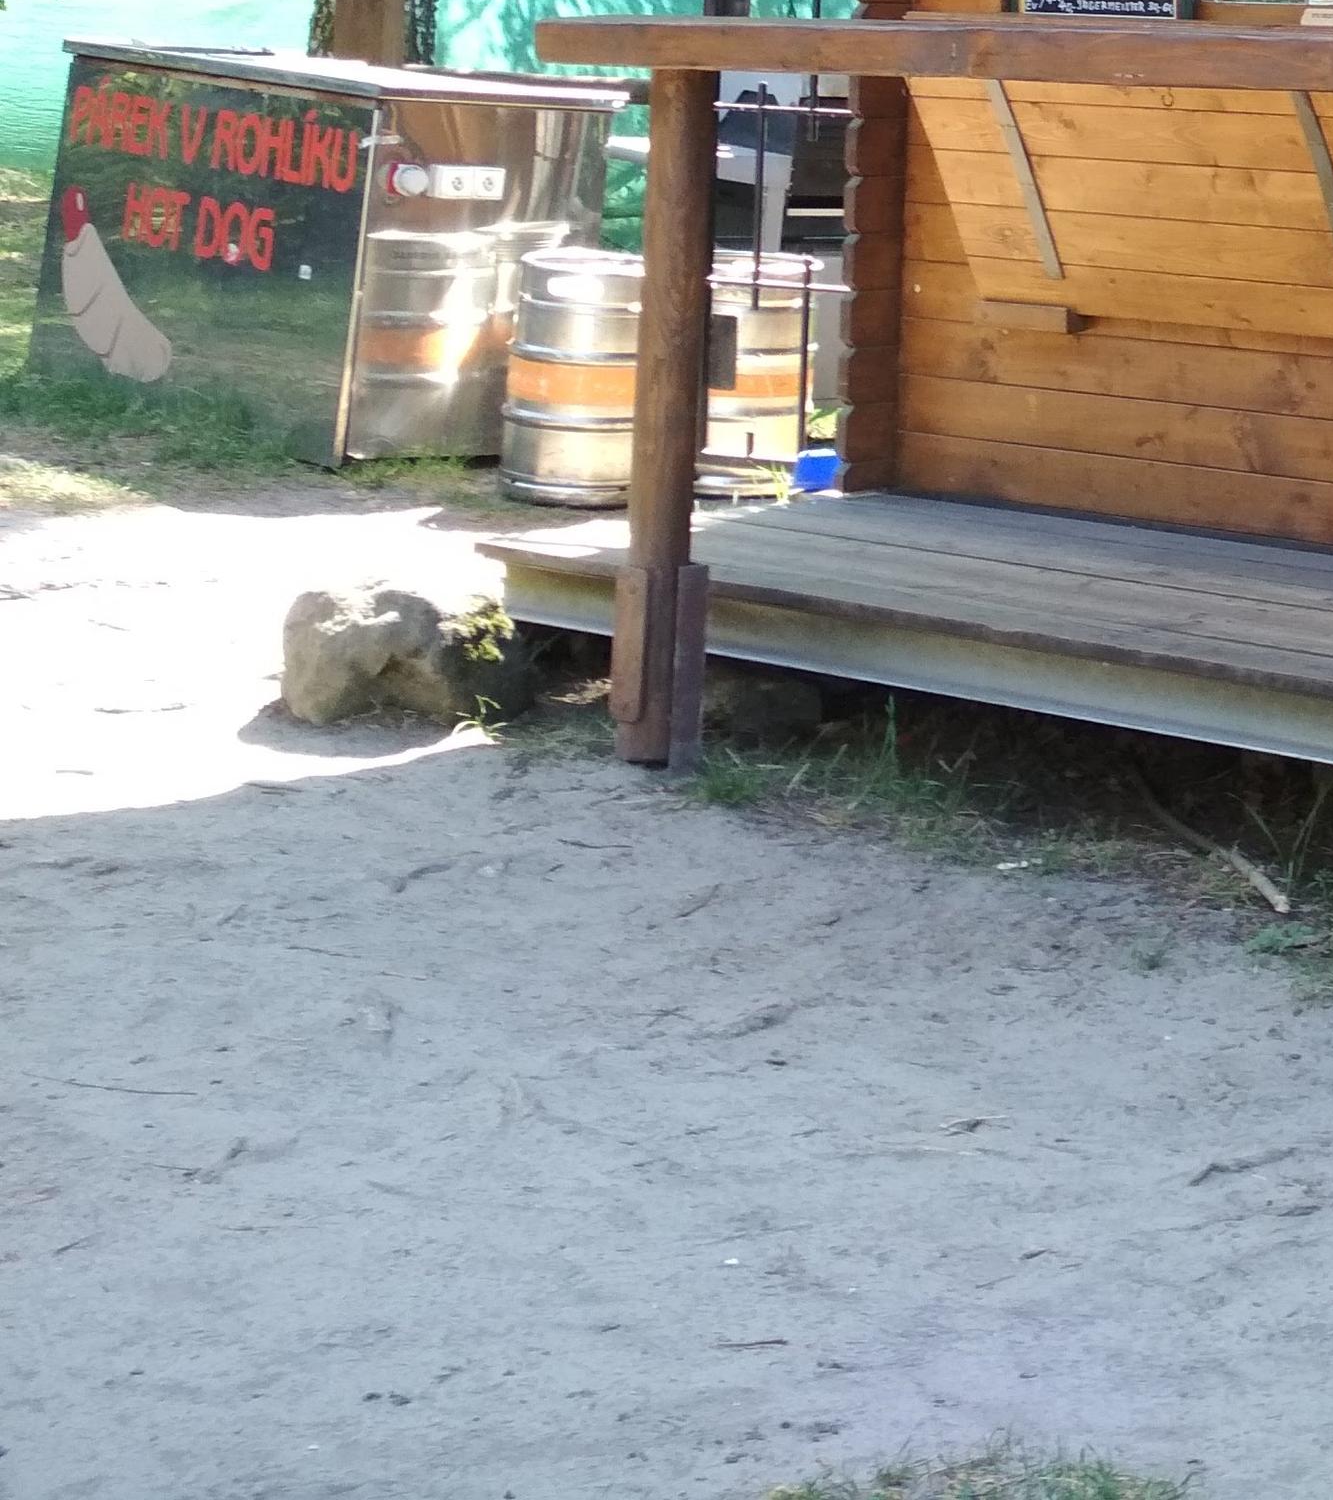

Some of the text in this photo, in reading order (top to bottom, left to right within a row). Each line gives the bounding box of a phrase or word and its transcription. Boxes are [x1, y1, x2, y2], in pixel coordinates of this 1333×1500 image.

[69, 76, 360, 194] PÁREK V ROHLÍKU
[122, 182, 277, 272] HOT DOG
